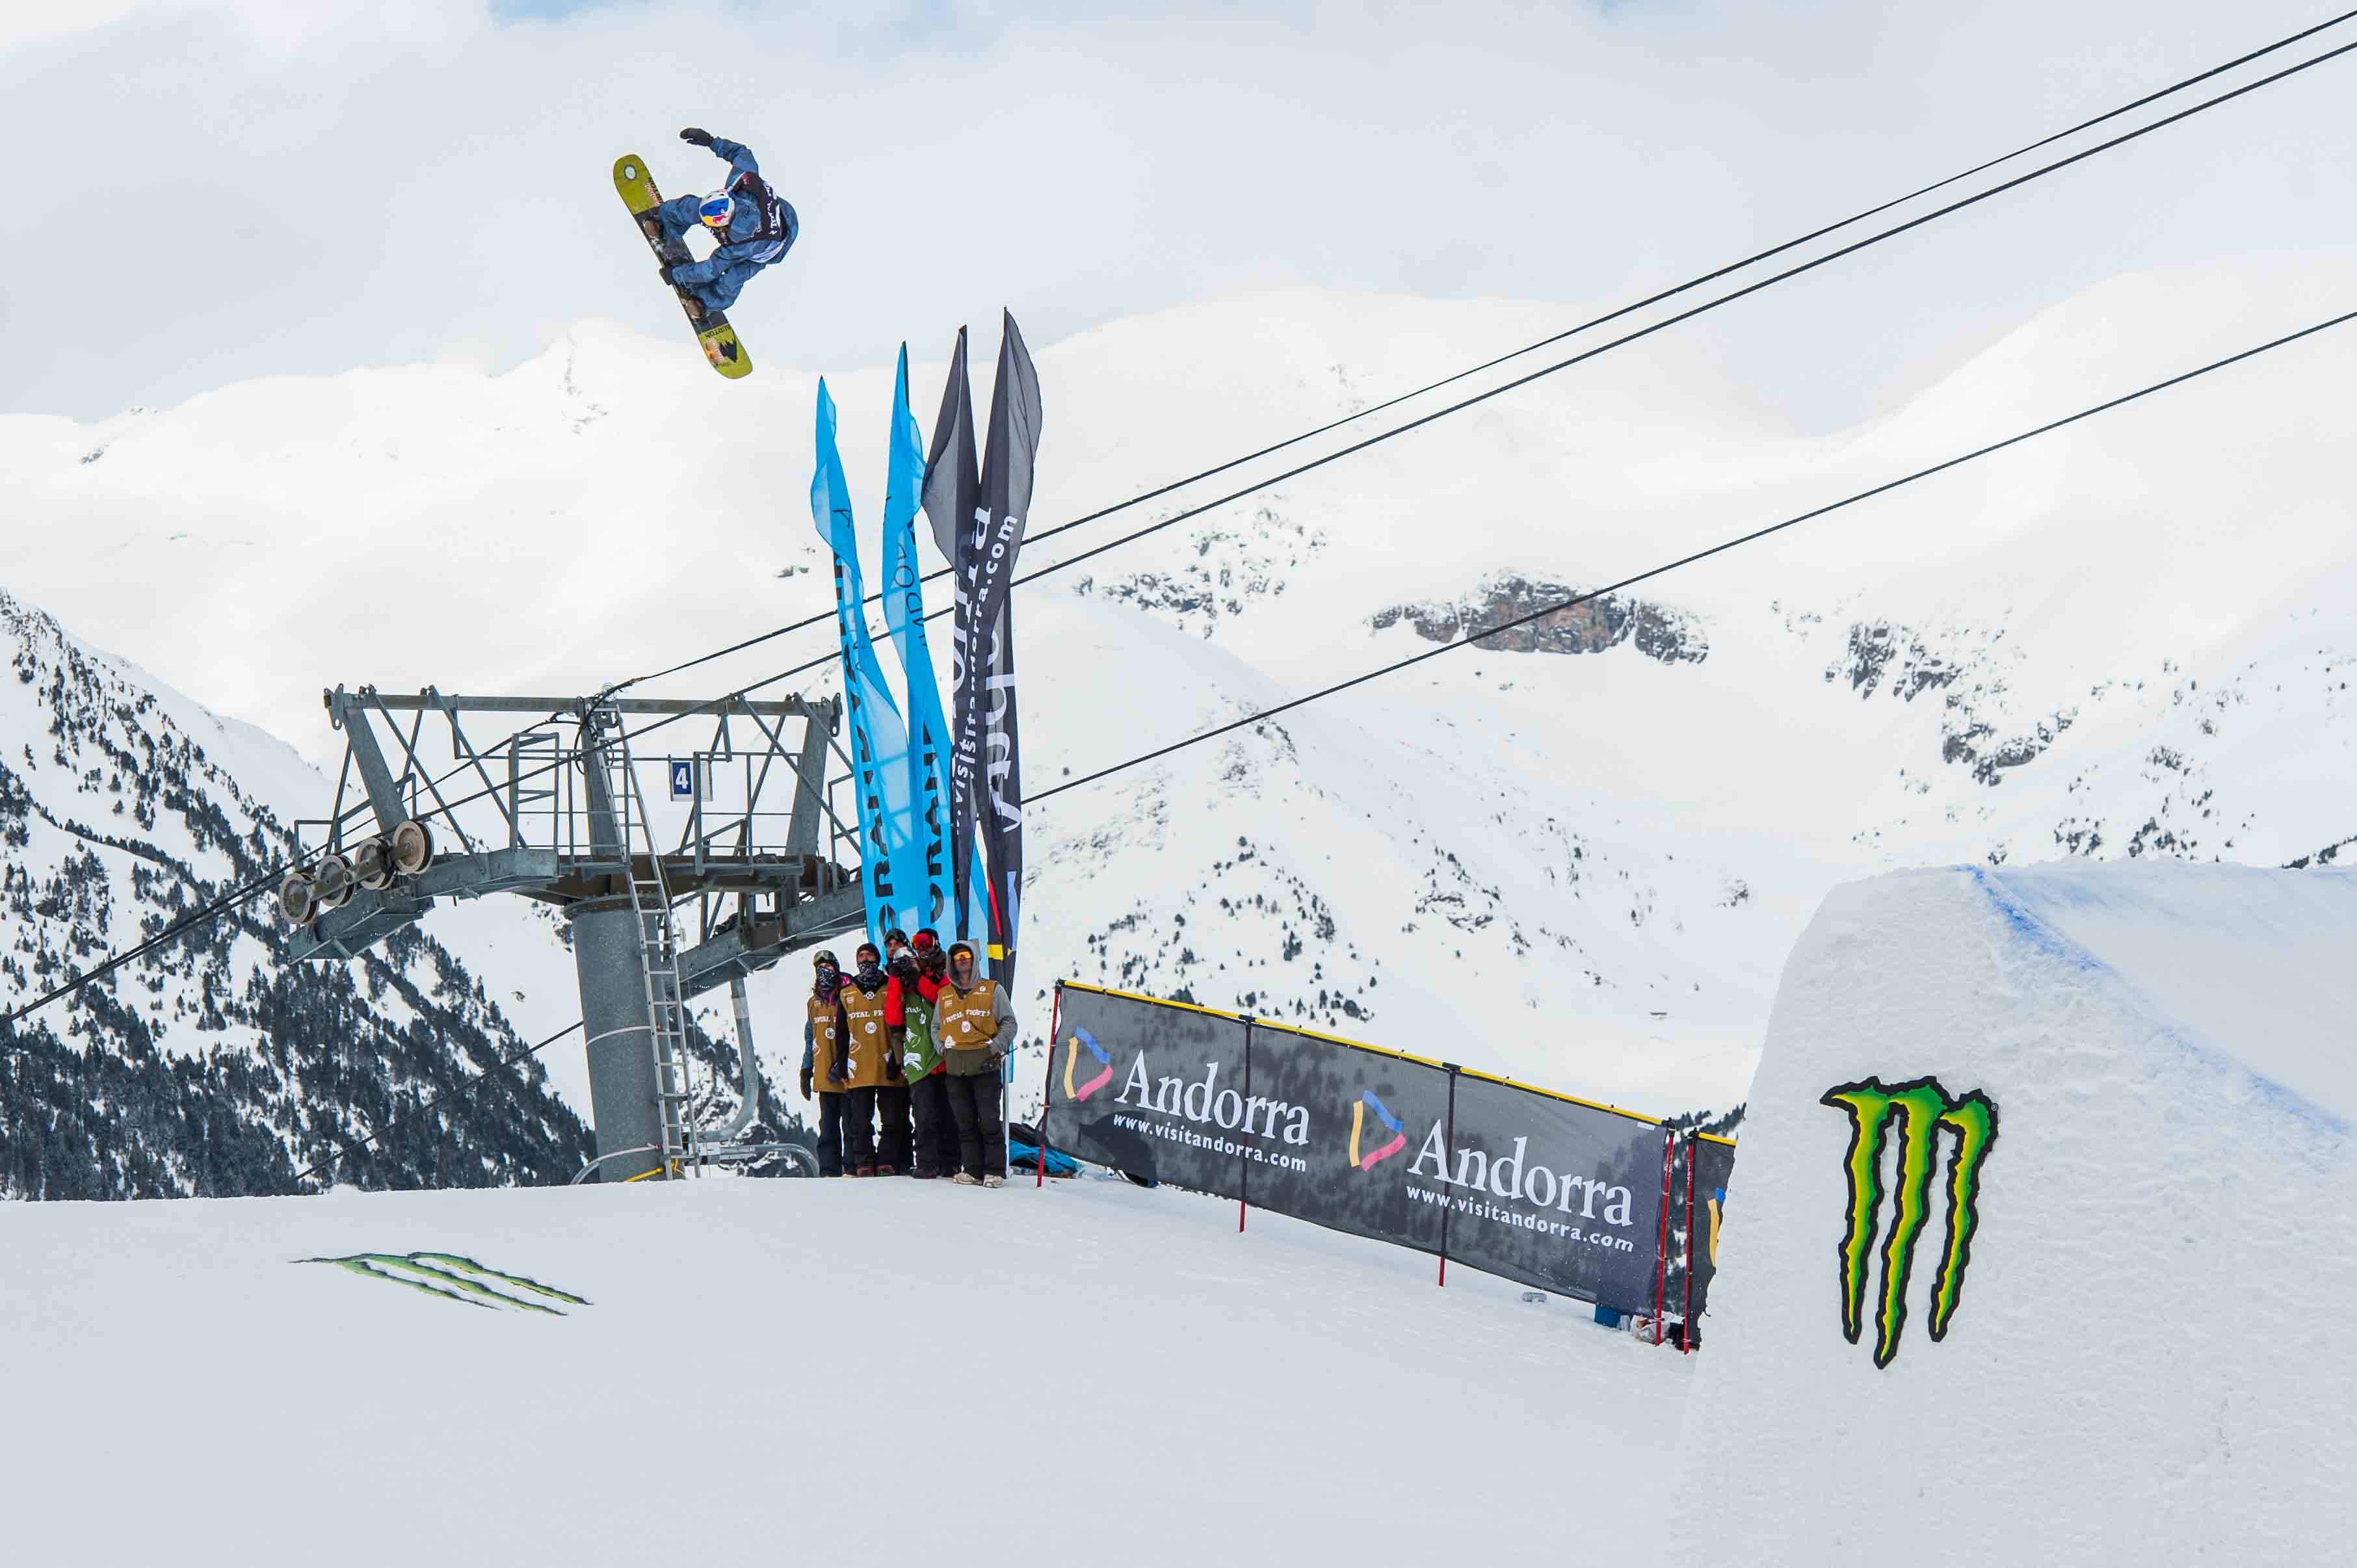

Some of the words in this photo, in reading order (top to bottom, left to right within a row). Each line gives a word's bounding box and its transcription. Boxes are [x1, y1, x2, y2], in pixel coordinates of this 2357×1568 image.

[675, 767, 689, 789] 4
[1114, 1049, 1310, 1145] Andorra
[1113, 1114, 1306, 1172] www.visitandorra.com
[1406, 1118, 1633, 1227] Andorra
[1406, 1185, 1634, 1253] www.visitandorra.com
